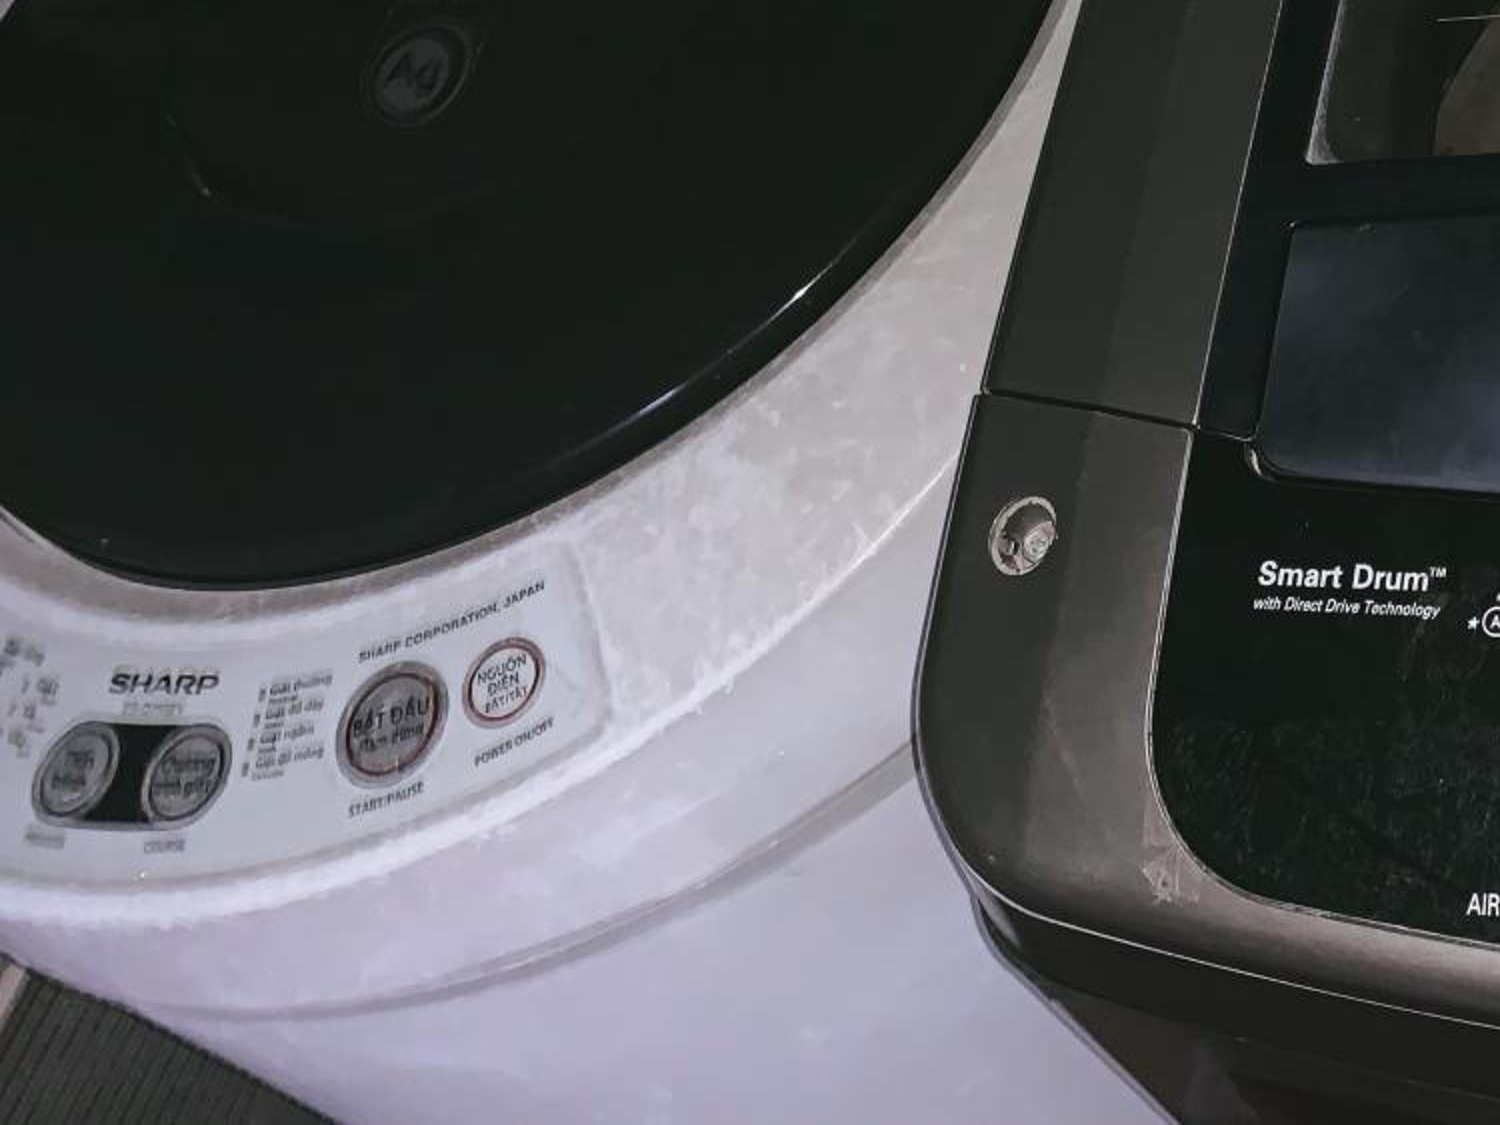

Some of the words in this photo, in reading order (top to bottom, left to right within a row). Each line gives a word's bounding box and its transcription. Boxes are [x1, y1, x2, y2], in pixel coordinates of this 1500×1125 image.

[1257, 560, 1344, 589] Smart
[502, 579, 546, 608] JAPAN
[1253, 597, 1282, 611] with
[1284, 596, 1324, 613] Direct
[1325, 598, 1360, 614] Drive
[1364, 600, 1441, 620] Technology
[108, 672, 220, 696] SHARP
[474, 739, 513, 768] POWER
[1466, 892, 1500, 916] AIR
